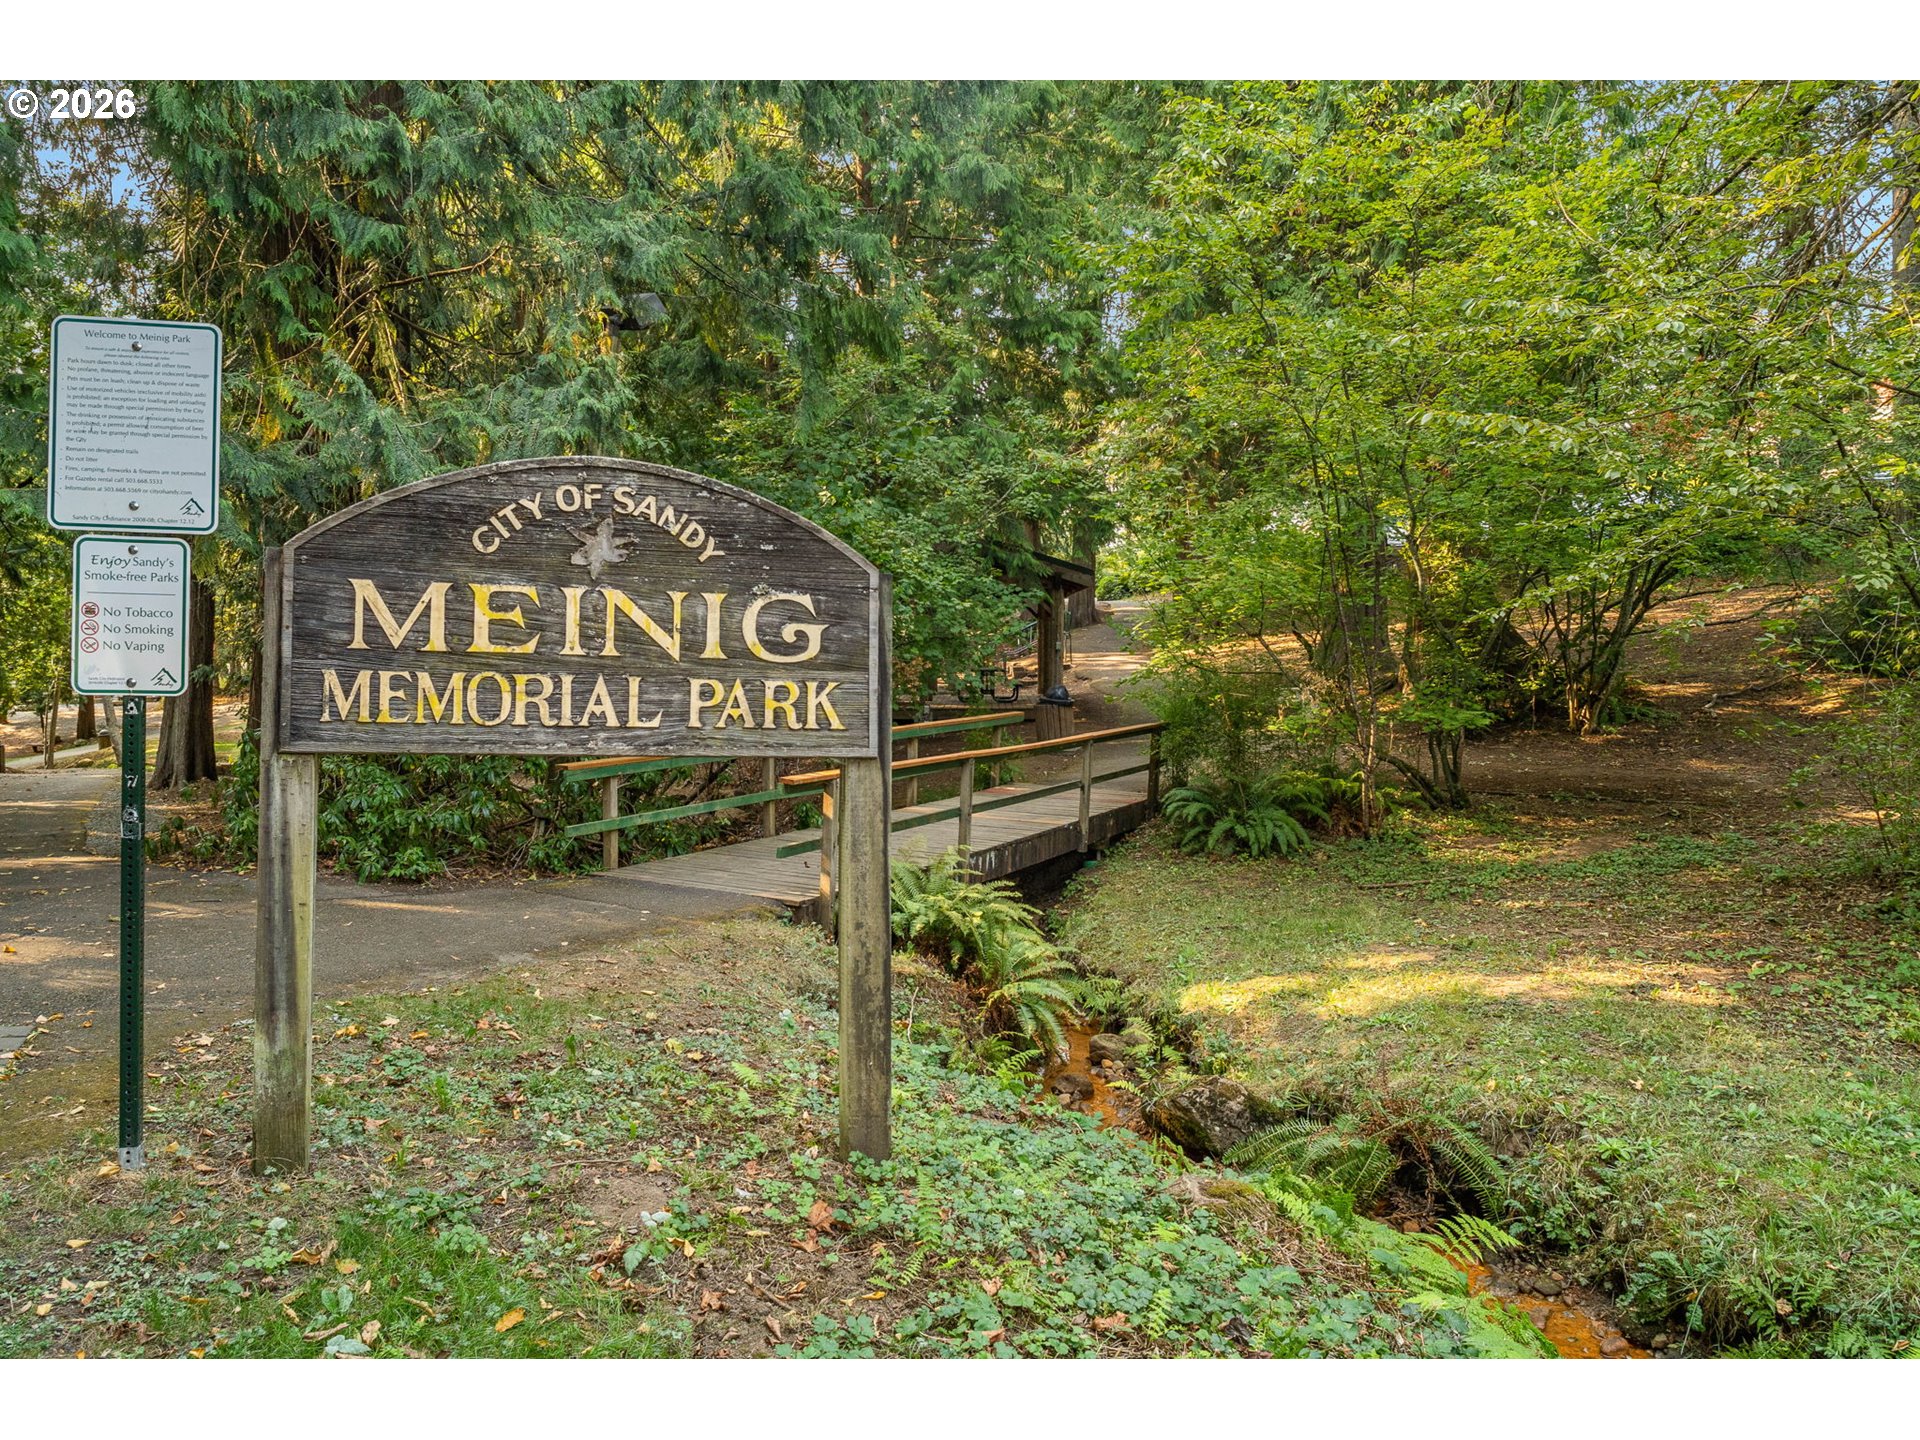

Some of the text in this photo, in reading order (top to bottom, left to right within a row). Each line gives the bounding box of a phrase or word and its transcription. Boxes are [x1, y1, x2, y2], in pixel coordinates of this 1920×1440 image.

[84, 329, 191, 343] Welcome to Meinig Park
[471, 483, 726, 563] CITY OF SANDY
[91, 554, 174, 569] Enjoy Sandy's
[84, 570, 179, 583] Smoke-free Parks
[103, 606, 174, 618] No Tobacco
[346, 577, 829, 664] MEINIG
[103, 624, 174, 637] No Smoking
[102, 640, 165, 654] No Vaping
[319, 668, 846, 730] MEMORIAL PARK
